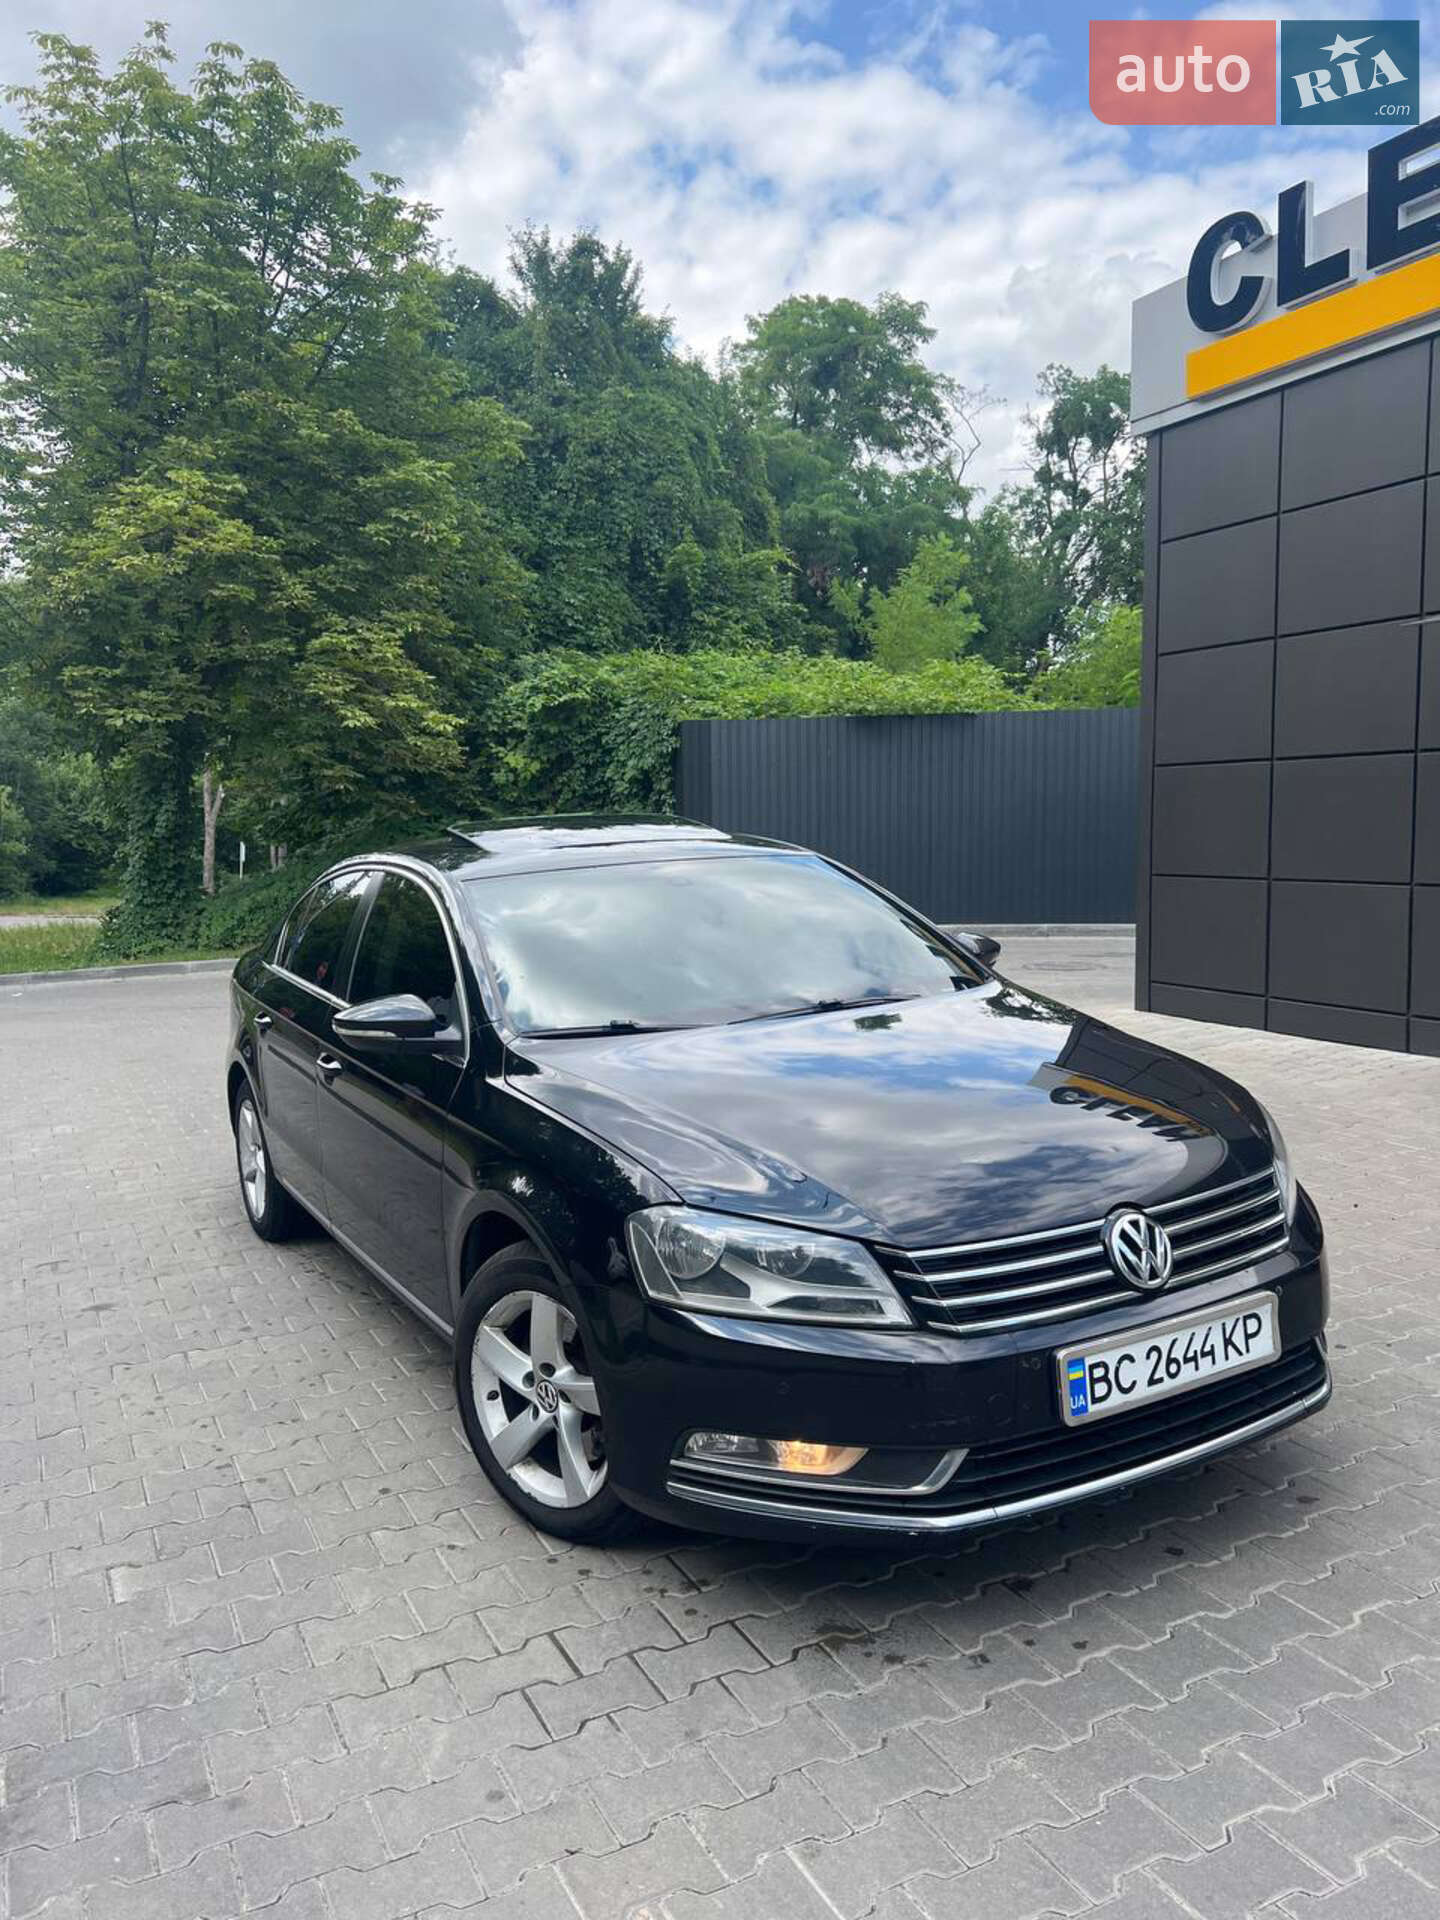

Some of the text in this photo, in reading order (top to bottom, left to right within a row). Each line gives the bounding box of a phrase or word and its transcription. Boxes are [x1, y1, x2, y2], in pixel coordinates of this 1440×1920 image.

[1186, 115, 1440, 333] CLE
[1070, 1395, 1086, 1409] UA
[1088, 1312, 1262, 1405] BC 2644 KP
